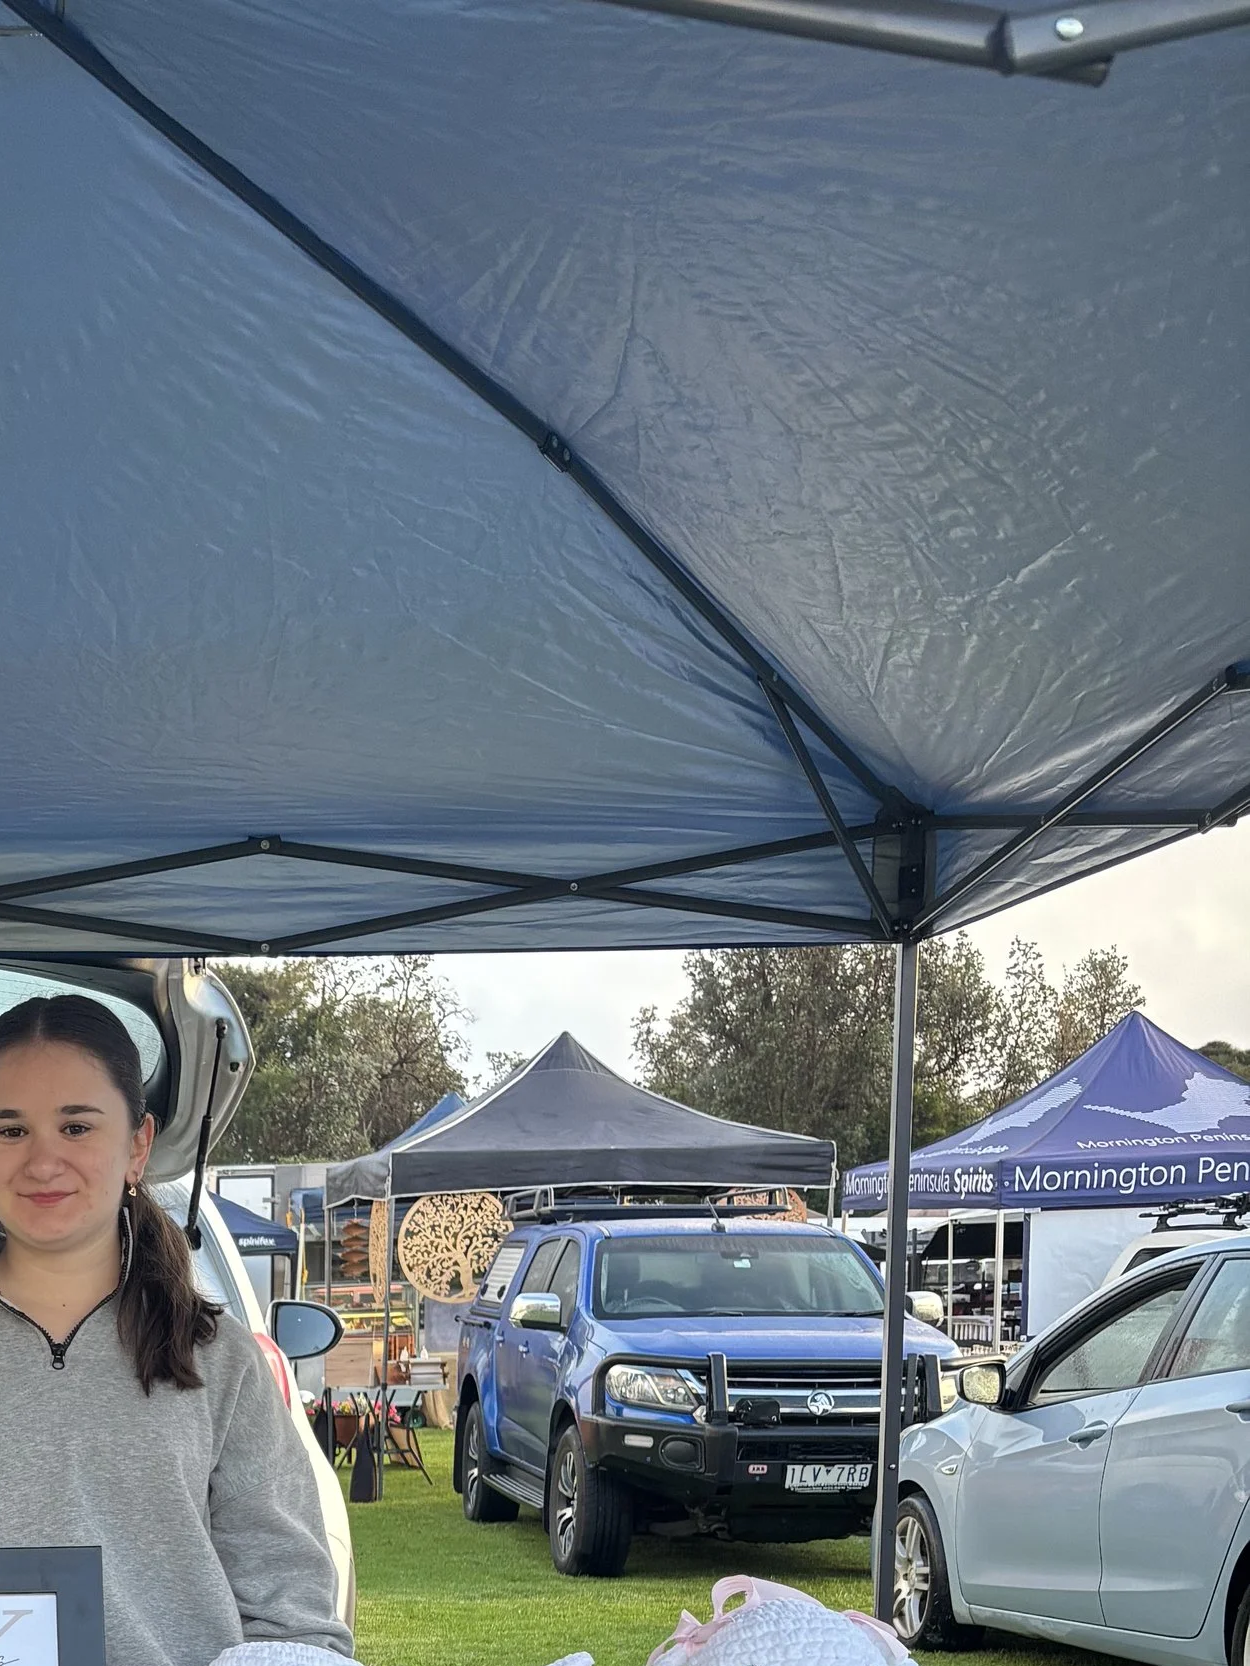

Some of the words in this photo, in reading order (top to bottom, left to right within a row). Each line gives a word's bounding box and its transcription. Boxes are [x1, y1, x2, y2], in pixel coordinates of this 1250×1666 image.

[1077, 1132, 1187, 1150] Mornington
[908, 1167, 950, 1193] eninsula
[953, 1166, 994, 1199] Spirits
[1014, 1162, 1186, 1194] Mornington
